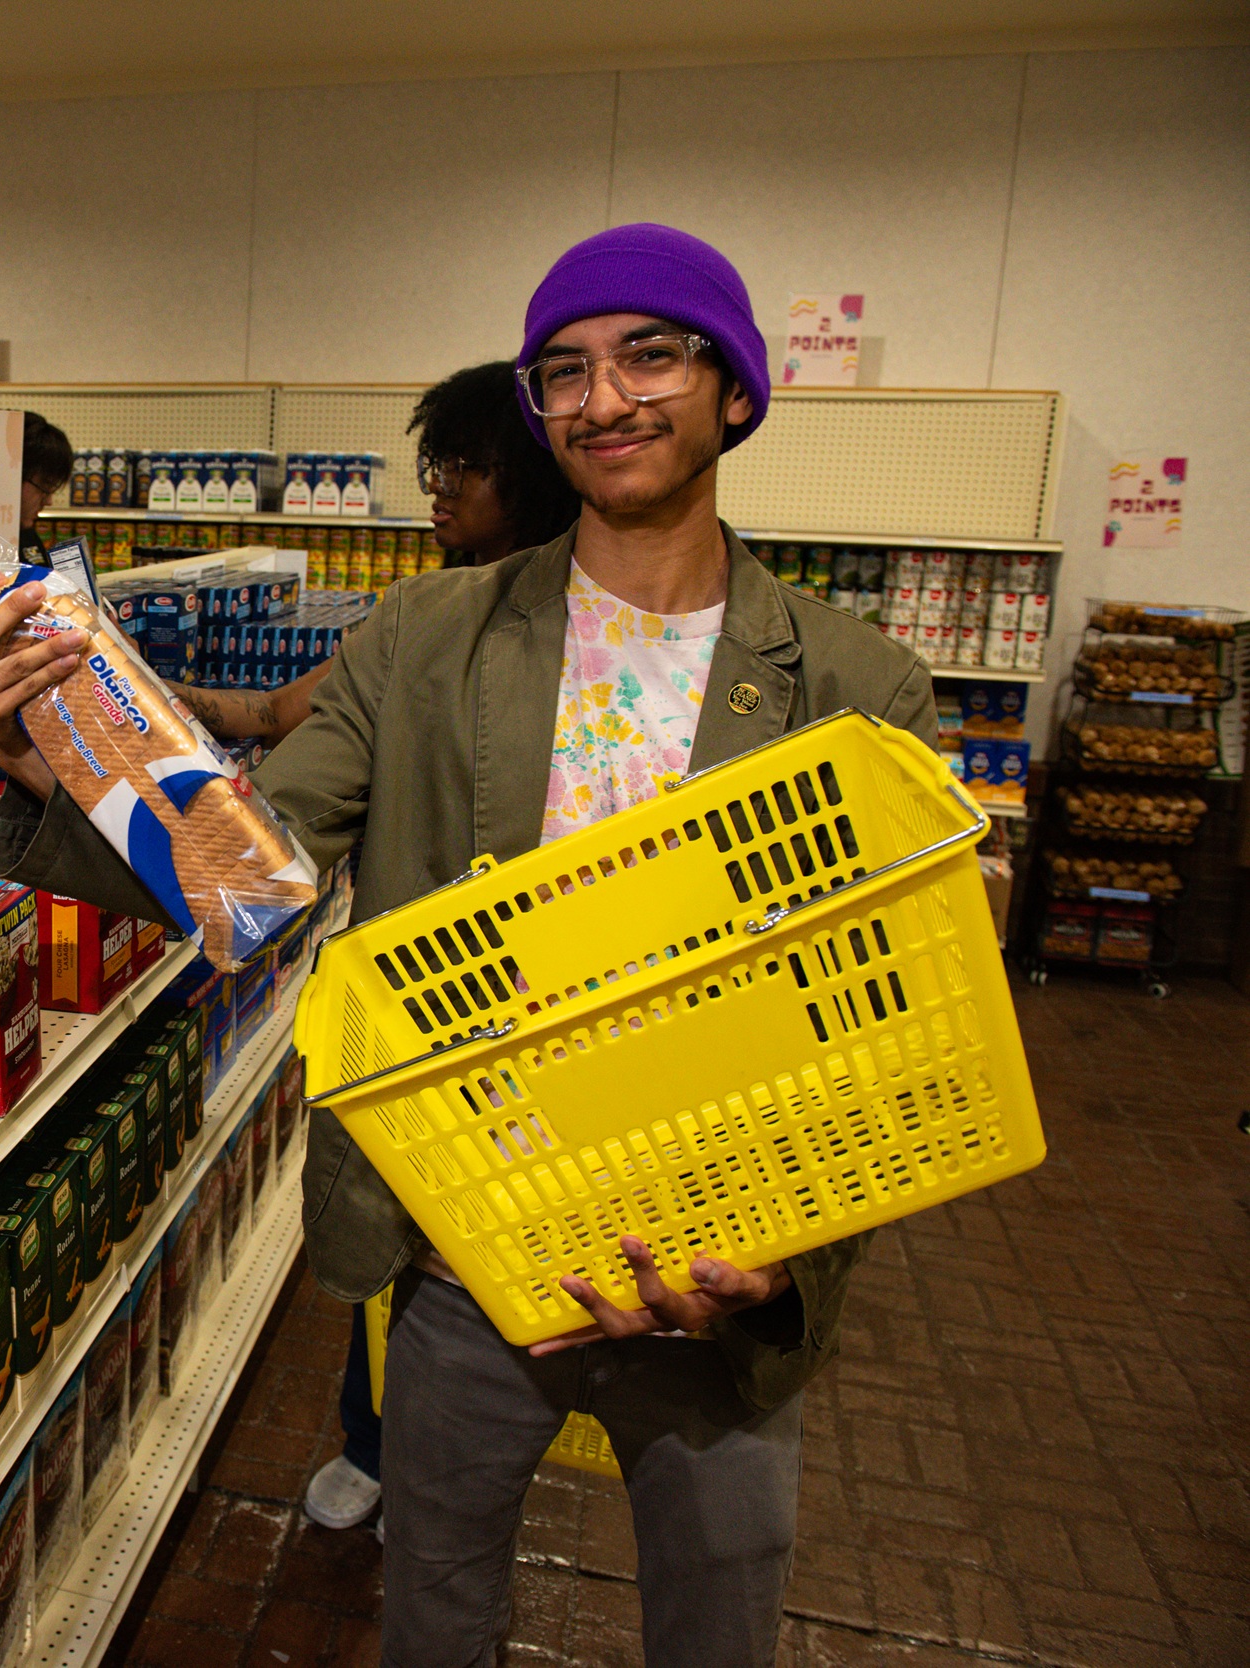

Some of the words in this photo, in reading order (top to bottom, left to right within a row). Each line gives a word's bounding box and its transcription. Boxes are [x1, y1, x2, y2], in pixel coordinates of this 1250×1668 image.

[819, 316, 831, 333] 2
[789, 336, 857, 352] POINTS
[1141, 479, 1154, 495] 2
[1110, 497, 1181, 514] POINTS
[119, 676, 136, 697] Pan
[92, 684, 125, 726] Grande
[54, 697, 74, 725] Large
[82, 748, 108, 779] Bread
[19, 892, 36, 920] PACK
[103, 920, 132, 961] HELPER
[4, 1003, 39, 1056] HELPER
[23, 1274, 41, 1302] Penne
